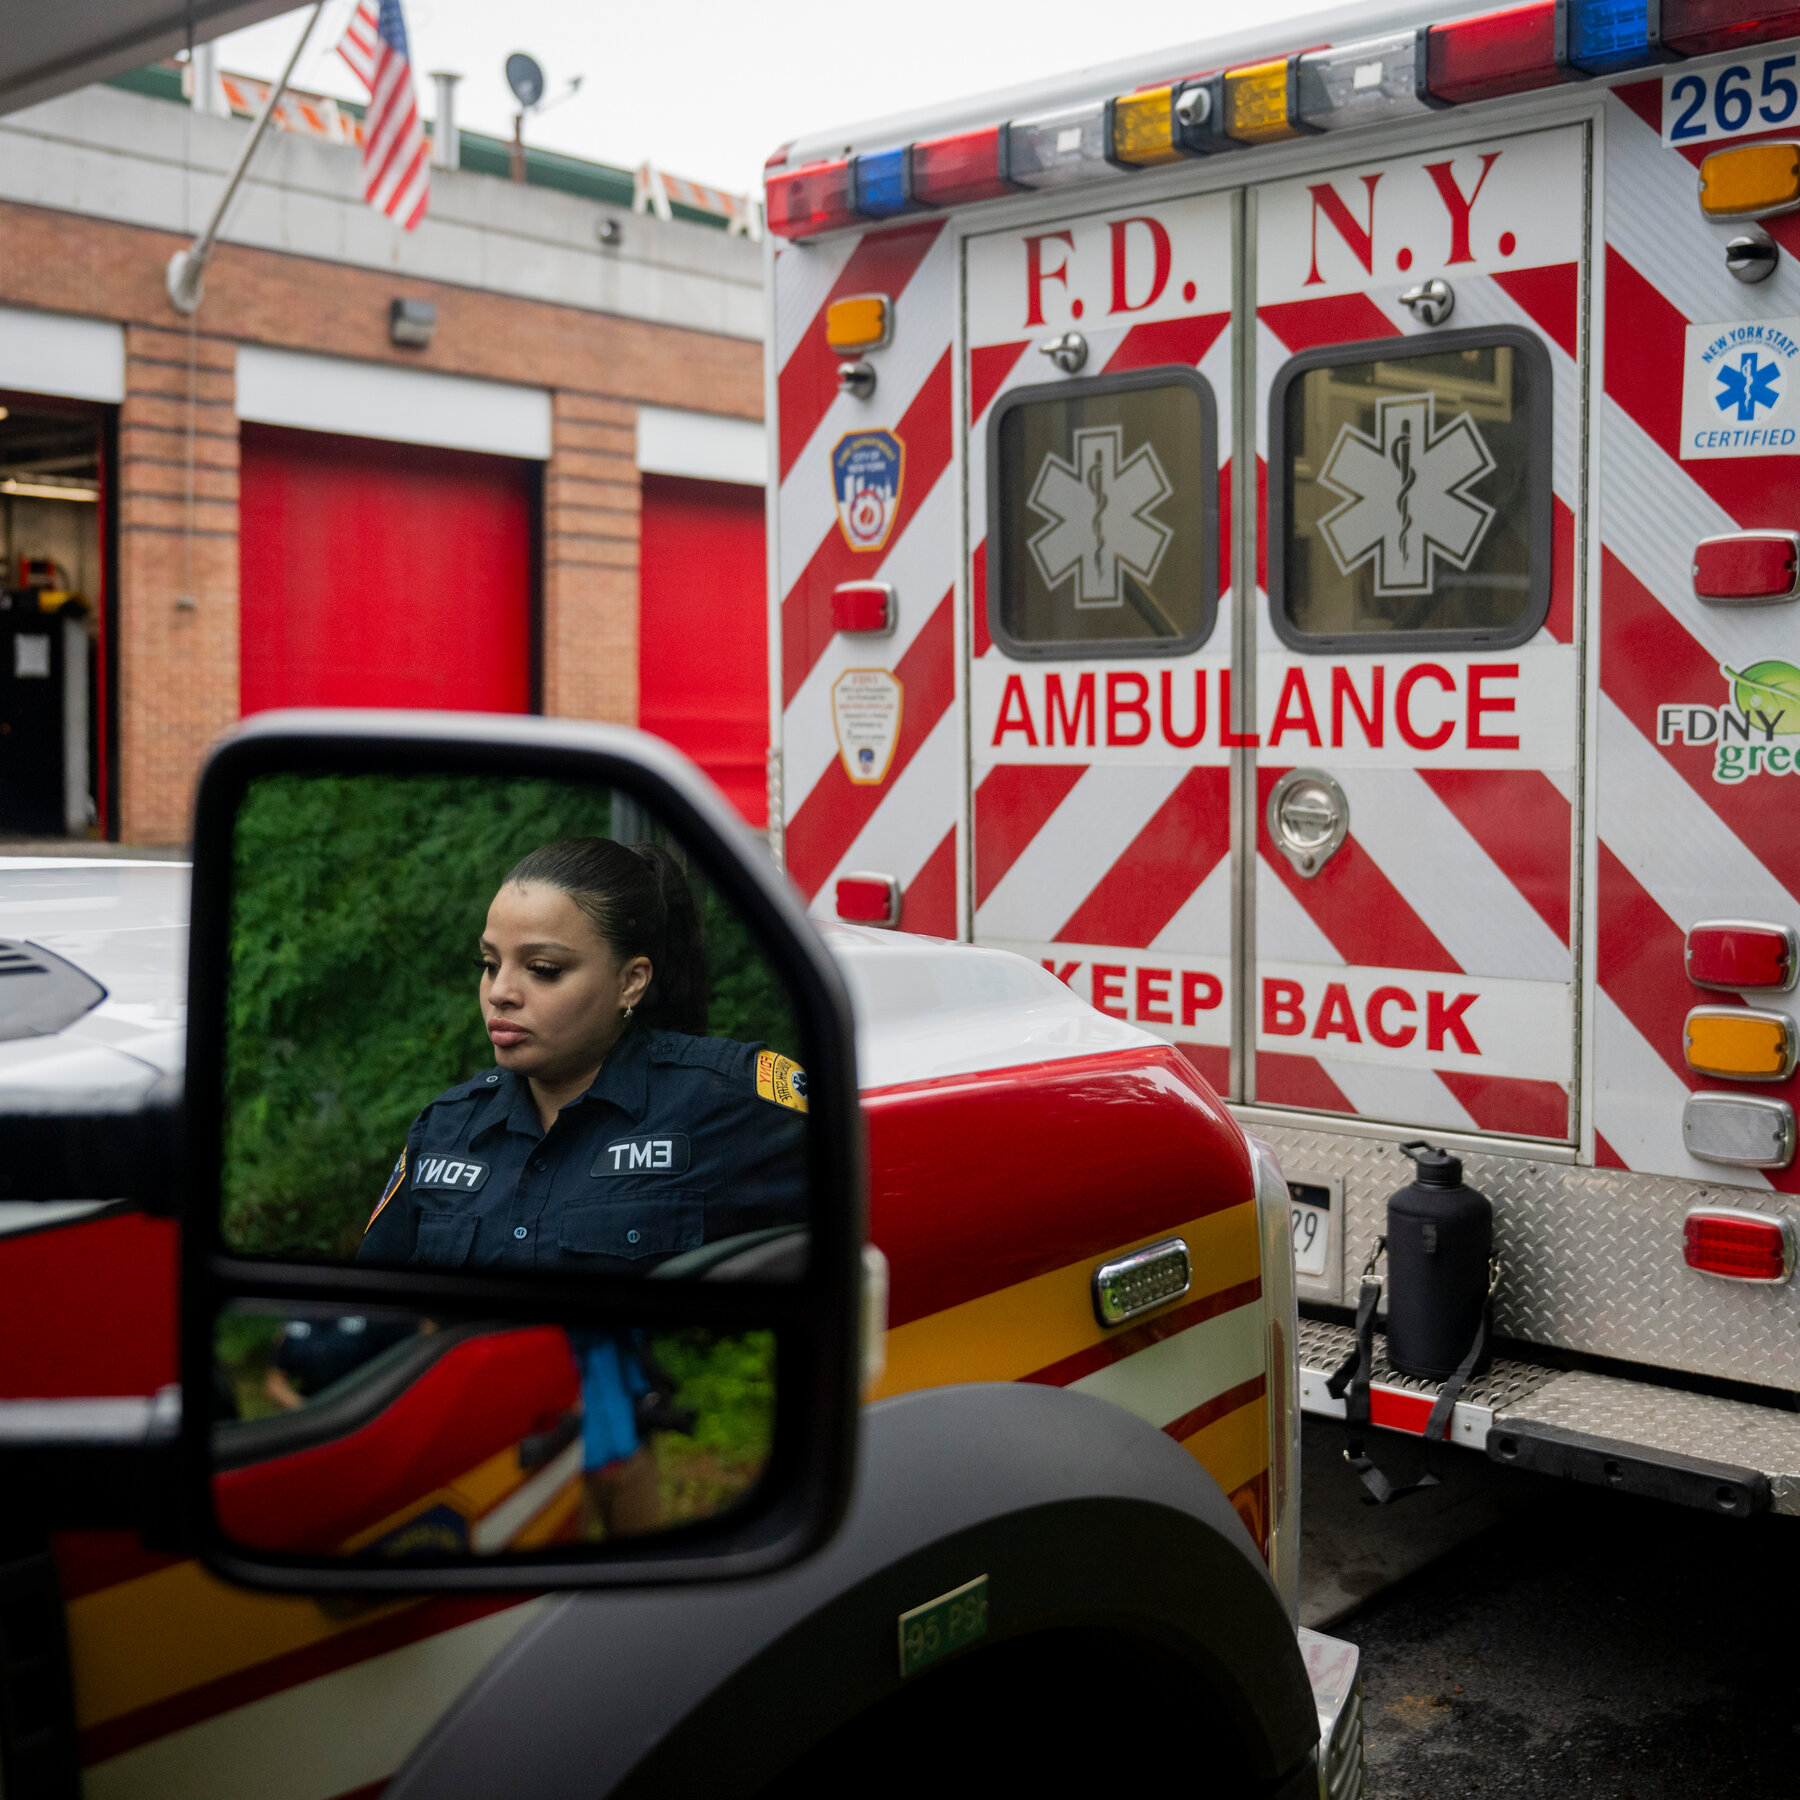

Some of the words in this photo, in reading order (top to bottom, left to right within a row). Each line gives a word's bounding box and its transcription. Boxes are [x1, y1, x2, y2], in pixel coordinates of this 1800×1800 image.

[1670, 54, 1798, 142] 265
[1701, 335, 1728, 364] NEW
[1728, 325, 1765, 342] YORK
[1764, 328, 1799, 358] STATE
[1694, 428, 1796, 449] CERTIFIED
[990, 662, 1520, 751] AMBULANCE
[1661, 709, 1785, 742] FDNY
[1717, 744, 1800, 780] gre
[1262, 977, 1482, 1056] BACK
